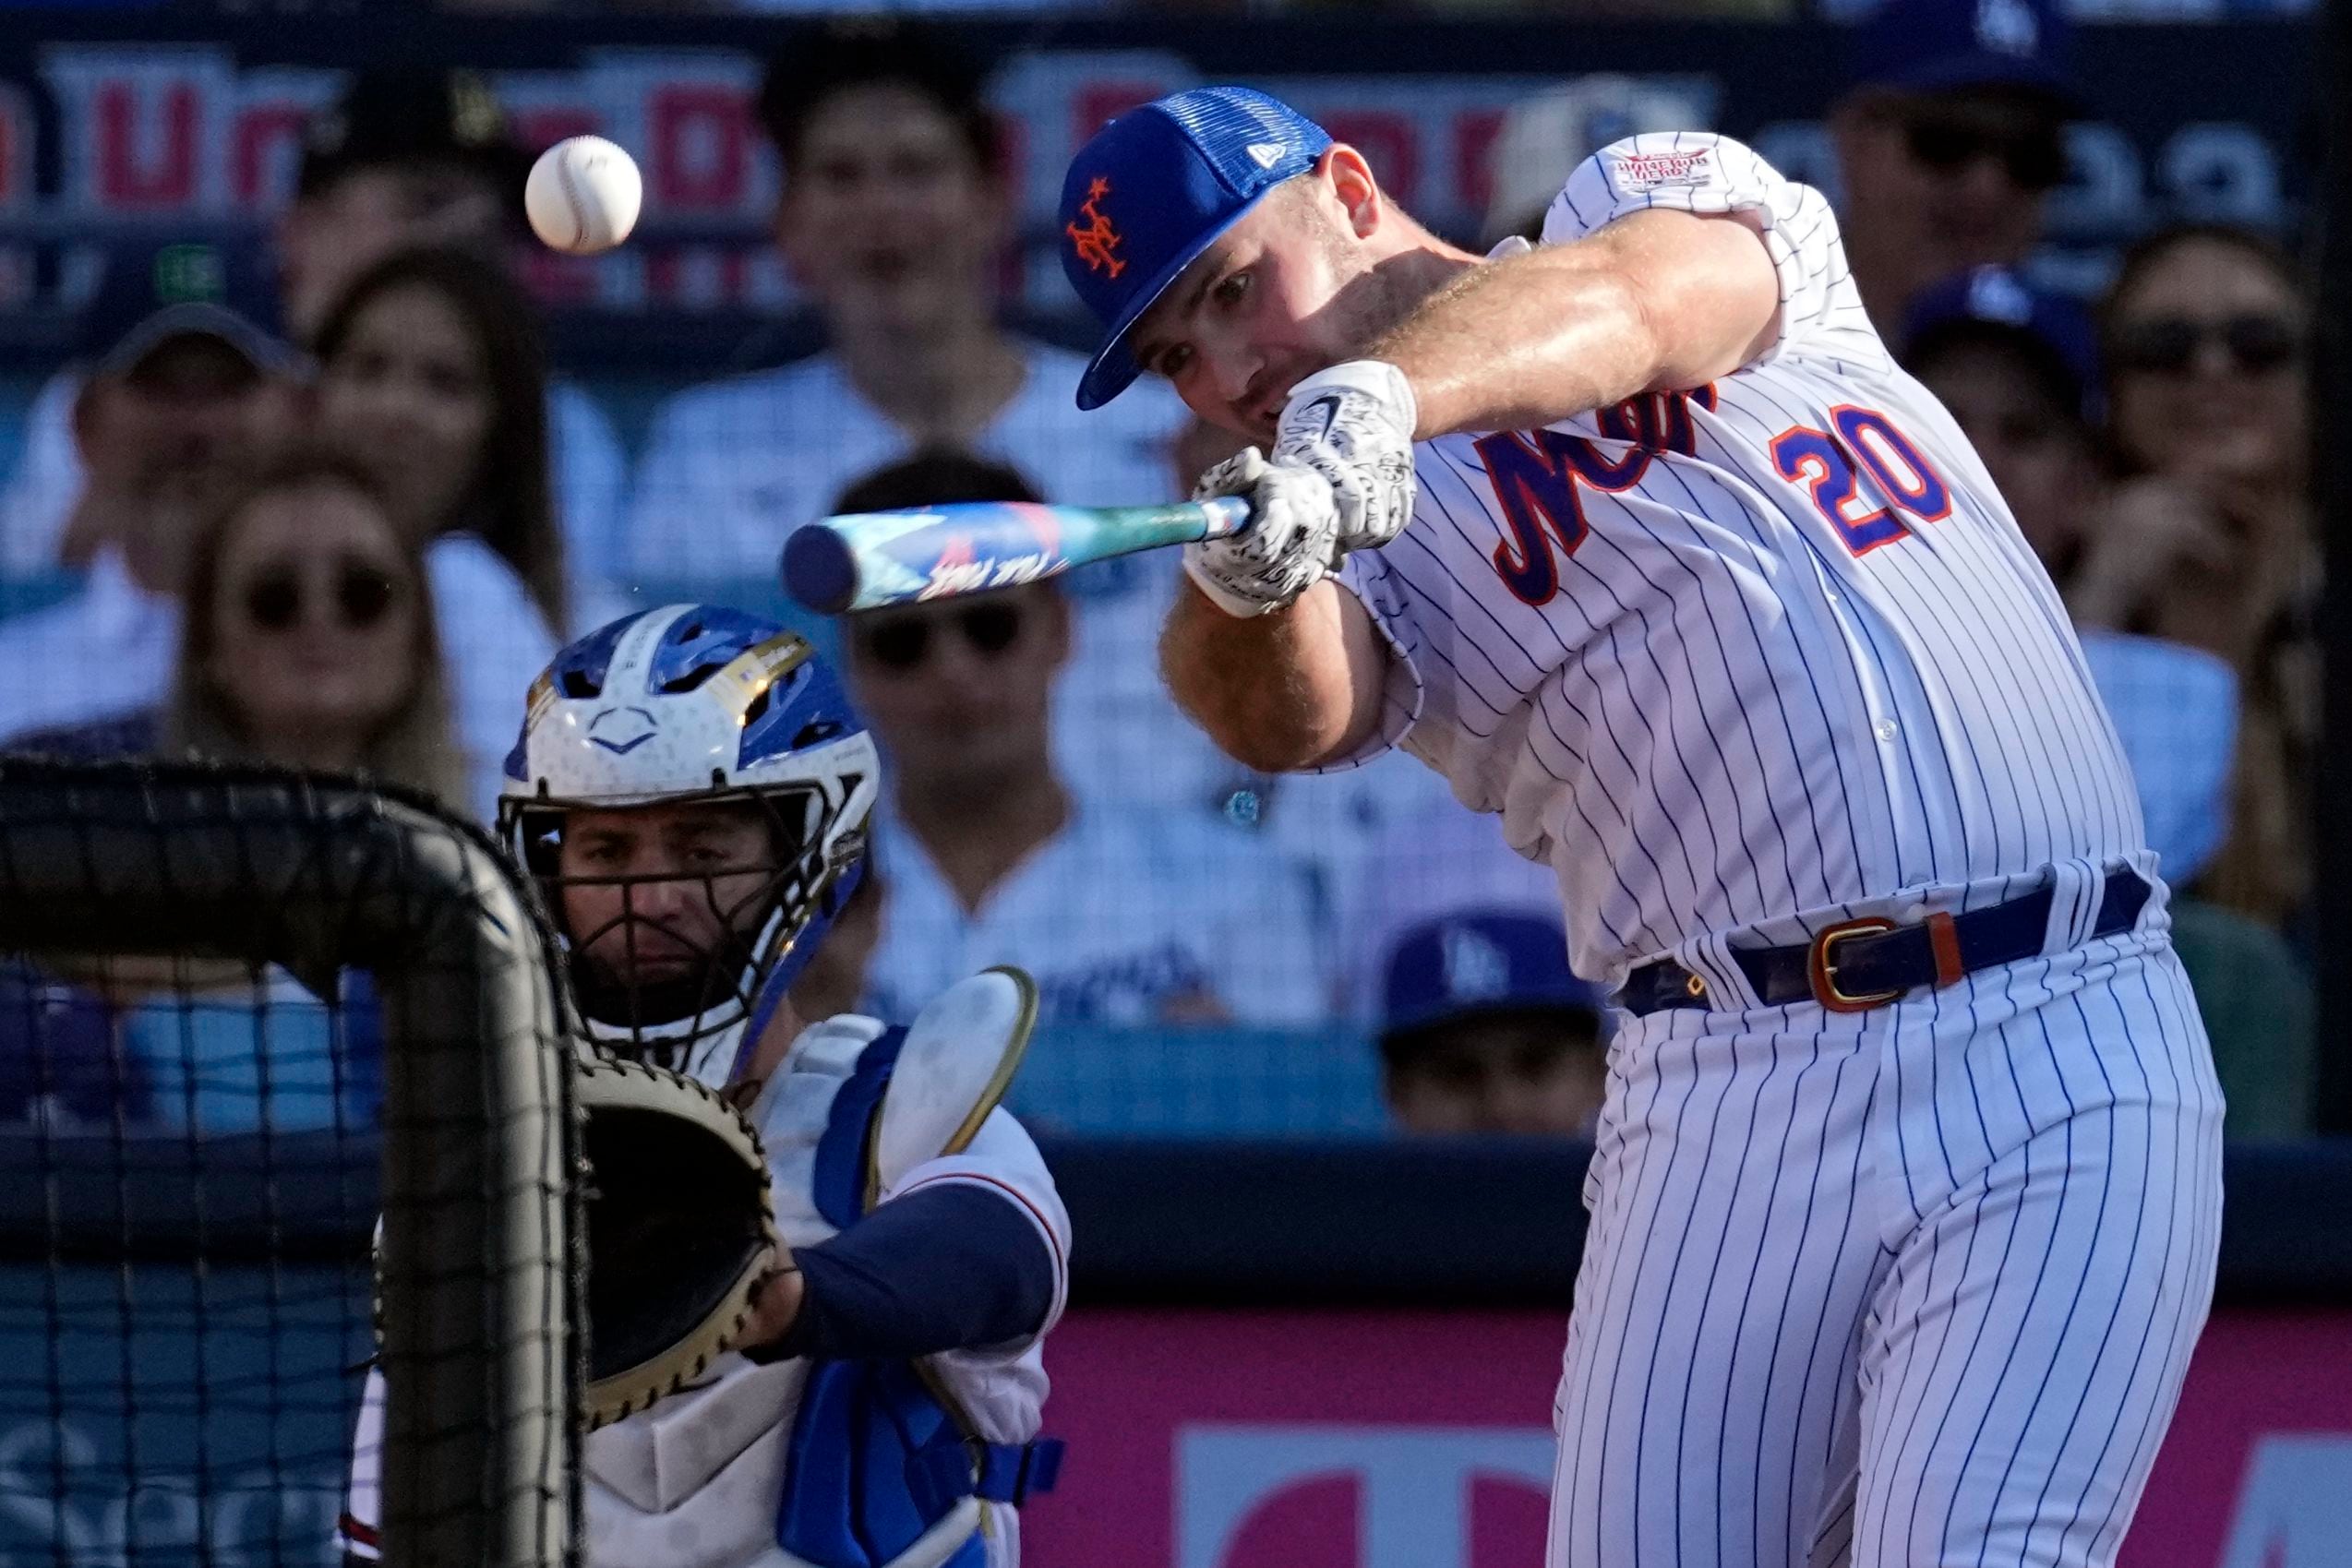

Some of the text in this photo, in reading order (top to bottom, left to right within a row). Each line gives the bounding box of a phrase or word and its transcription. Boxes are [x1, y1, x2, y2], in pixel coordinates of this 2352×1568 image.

[1617, 156, 1710, 173] HOME RUN
[1769, 403, 1952, 559] 20
